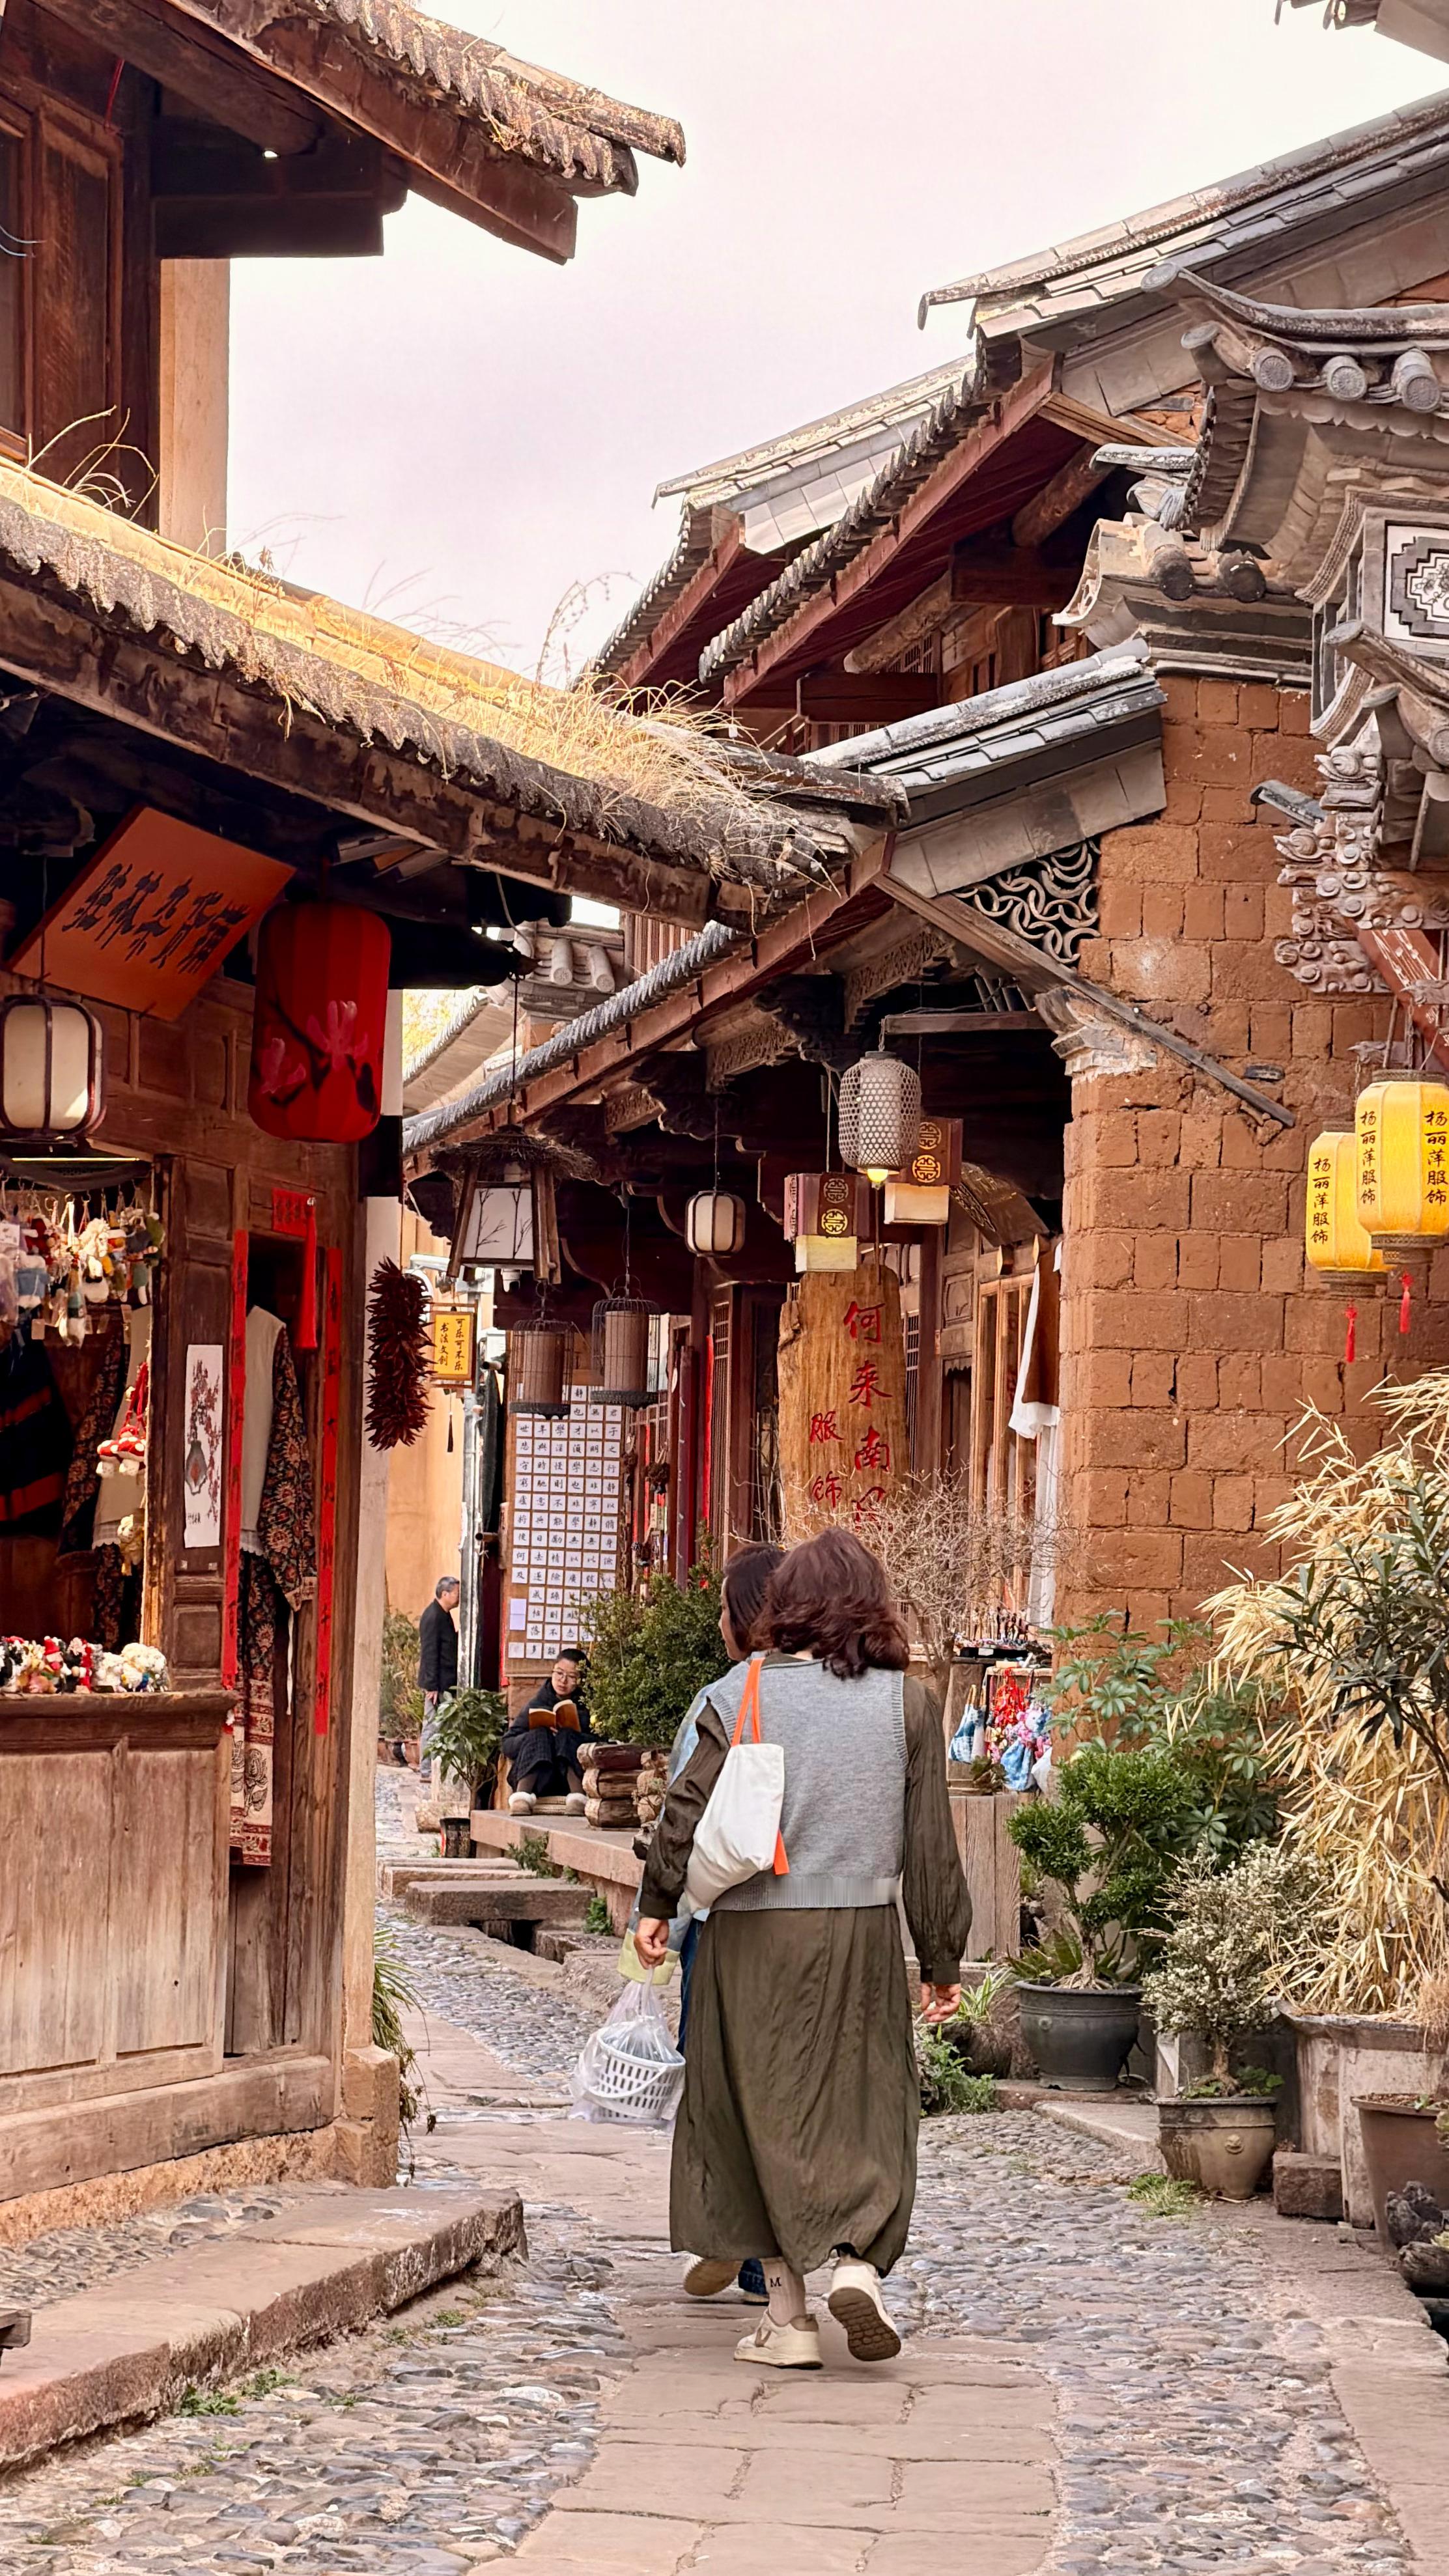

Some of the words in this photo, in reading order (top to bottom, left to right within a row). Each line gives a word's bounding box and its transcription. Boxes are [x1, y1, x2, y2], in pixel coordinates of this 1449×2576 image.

[1310, 1158, 1330, 1245] 杨丽萍服饰
[1360, 1111, 1377, 1205] 杨丽萍服饰
[1424, 1111, 1448, 1205] 杨丽萍服饰
[438, 1322, 449, 1366] 书法文创
[809, 1410, 845, 1509] 服饰
[770, 2276, 782, 2288] M
